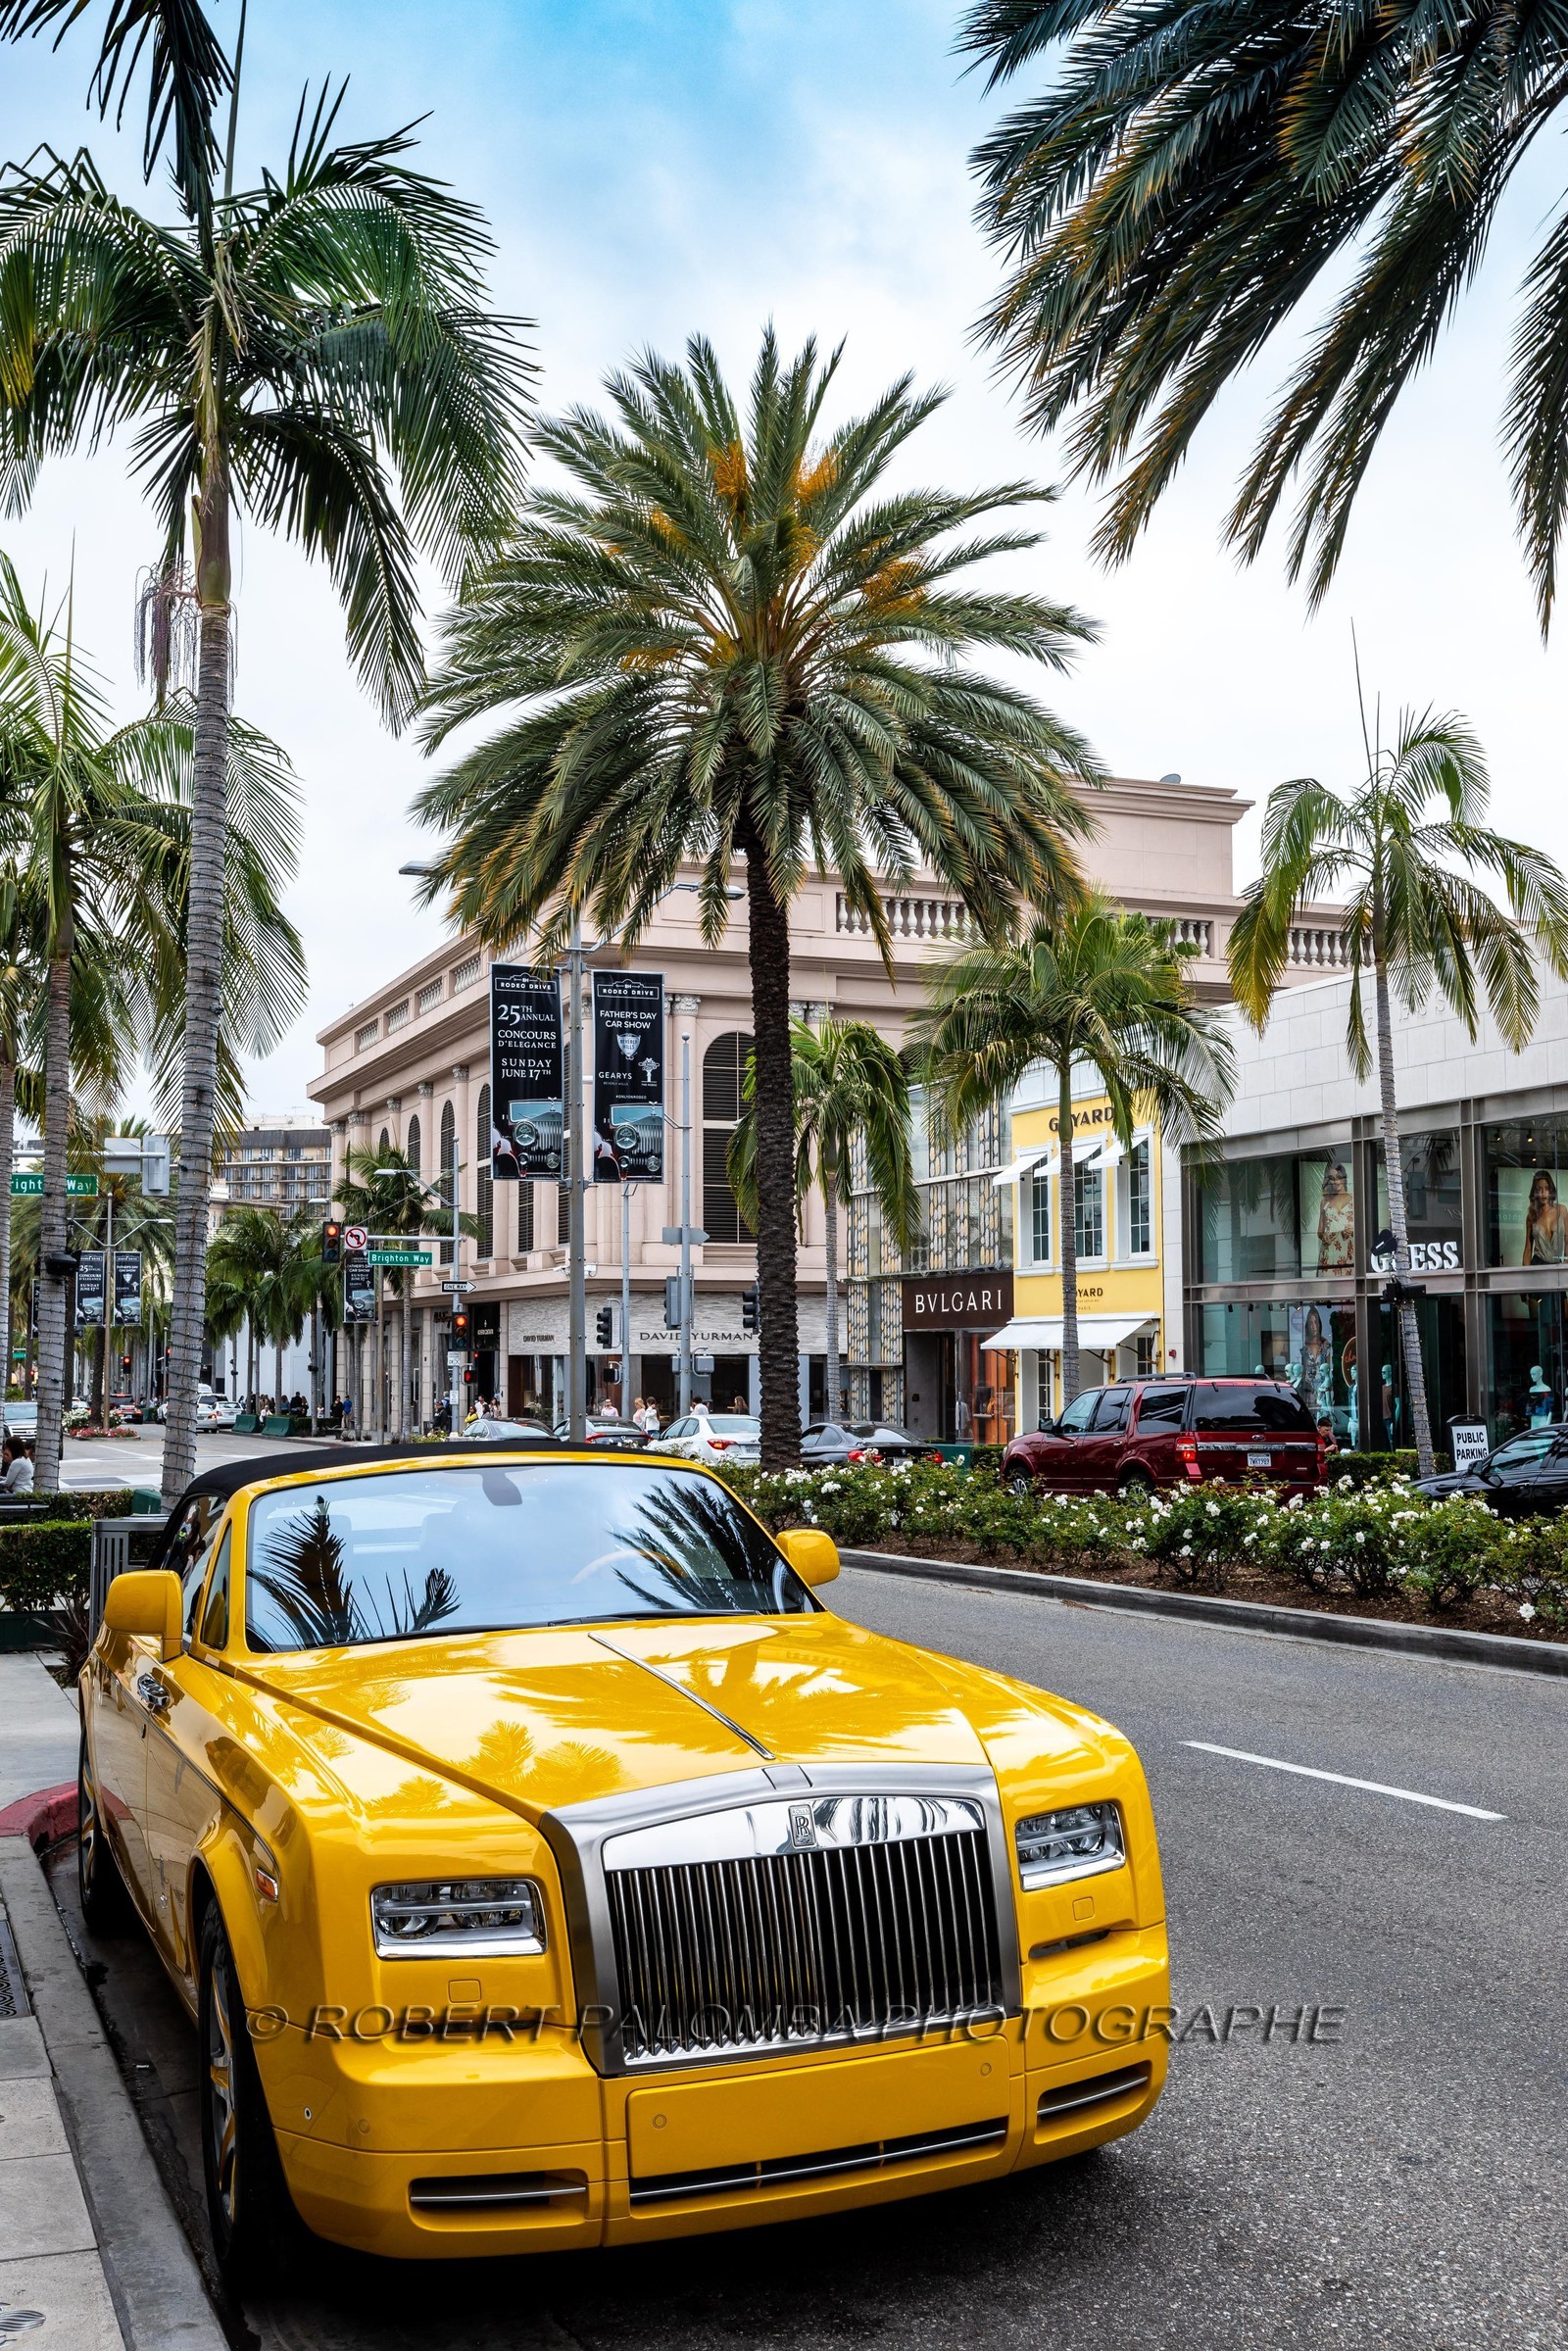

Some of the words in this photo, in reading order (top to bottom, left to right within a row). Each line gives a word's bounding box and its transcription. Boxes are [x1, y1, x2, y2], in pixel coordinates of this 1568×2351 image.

[600, 1009, 638, 1019] FATHER'S
[639, 1011, 657, 1020] DAY
[623, 1020, 651, 1029] SHOW
[498, 1029, 557, 1040] CONCOURS
[498, 1040, 557, 1049] D'ELEGANCE
[501, 1057, 552, 1068] SUNDAY
[501, 1068, 526, 1079] JUNE
[598, 1071, 632, 1080] GEARYS
[1049, 1106, 1114, 1132] GYARD
[67, 1179, 92, 1193] Way
[371, 1253, 410, 1264] Brighton
[413, 1254, 429, 1264] Way
[1370, 1242, 1460, 1273] GESS
[1076, 1288, 1103, 1298] YARD
[915, 1289, 1002, 1313] BVLGARI
[1456, 1432, 1485, 1445] PUBLIC
[1456, 1447, 1488, 1461] PARKING
